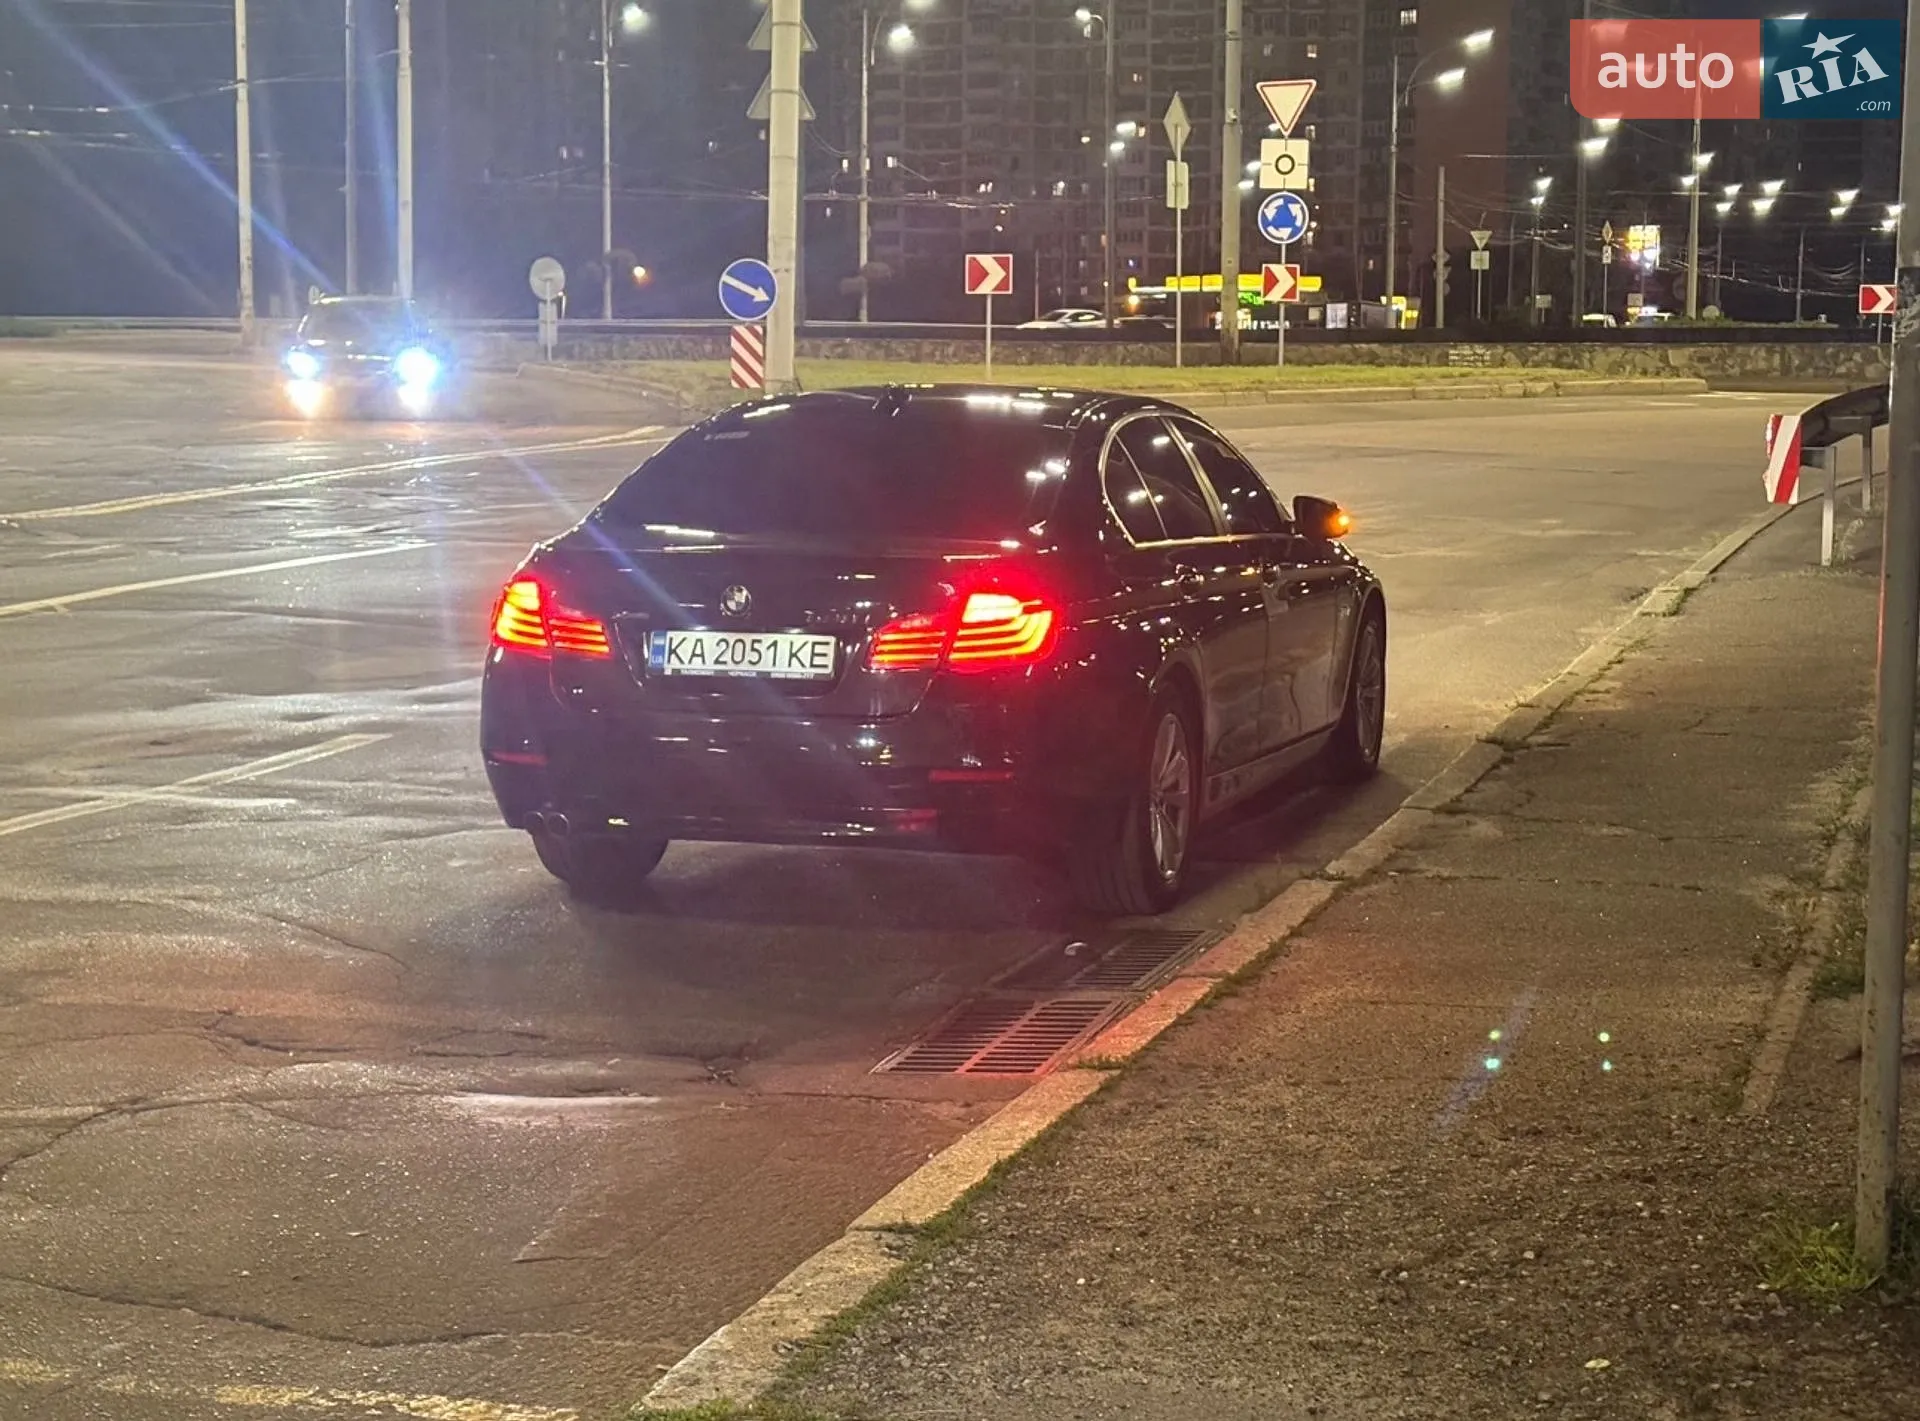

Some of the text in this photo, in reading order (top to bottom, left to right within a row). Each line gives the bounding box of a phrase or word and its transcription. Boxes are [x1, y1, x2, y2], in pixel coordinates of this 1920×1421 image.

[667, 636, 831, 668] KA 2051 KE
